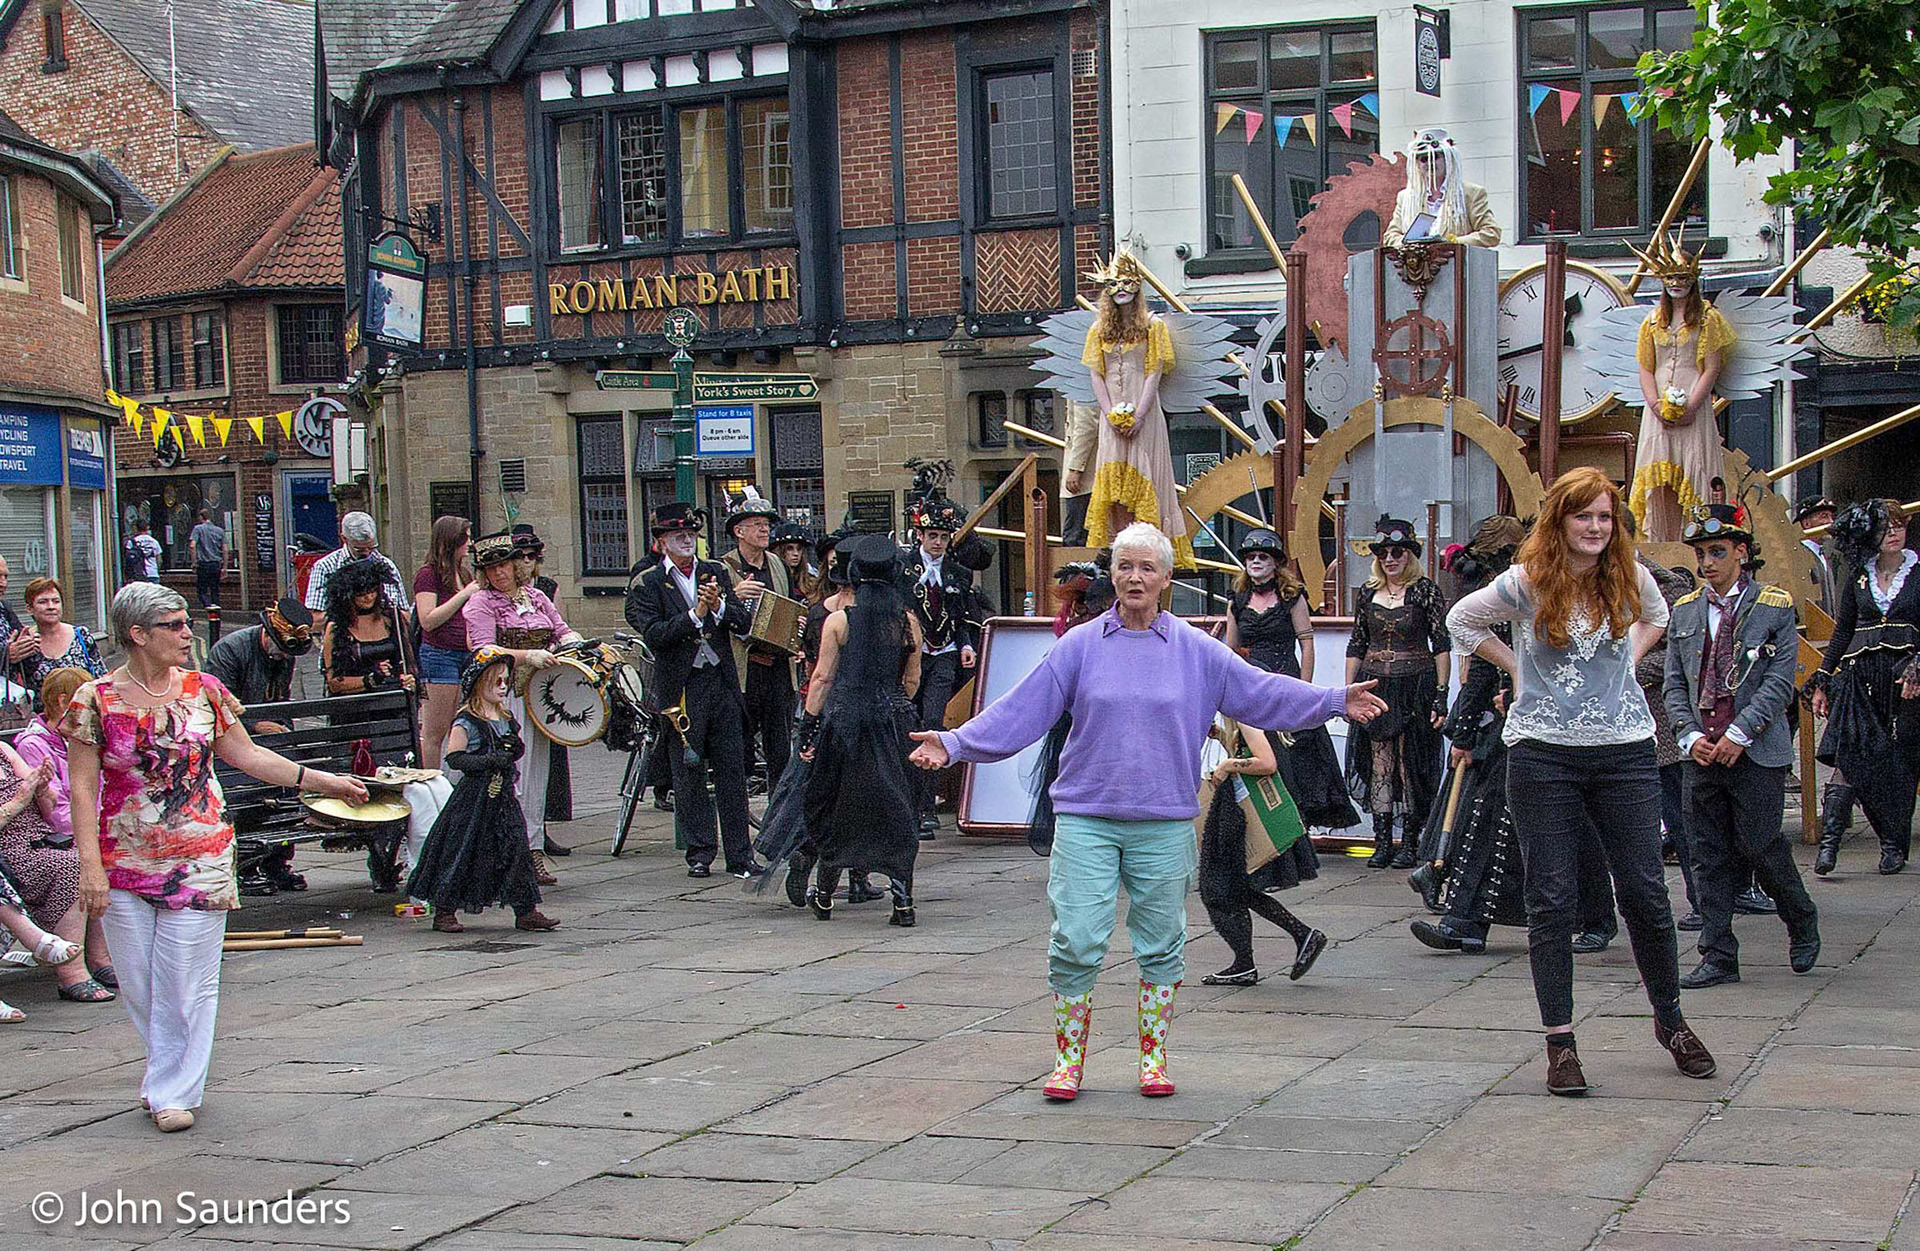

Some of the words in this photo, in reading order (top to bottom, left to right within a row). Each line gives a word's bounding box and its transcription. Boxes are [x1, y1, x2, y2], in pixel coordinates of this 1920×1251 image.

[549, 274, 679, 316] ROMAN
[696, 266, 791, 305] BATH
[603, 374, 622, 386] Castle
[622, 376, 640, 387] Area
[696, 386, 730, 399] York's
[732, 385, 765, 398] Sweet
[766, 385, 796, 398] Story
[698, 410, 717, 418] Stand
[718, 410, 729, 418] for
[729, 409, 735, 417] 8
[736, 408, 752, 417] taxis
